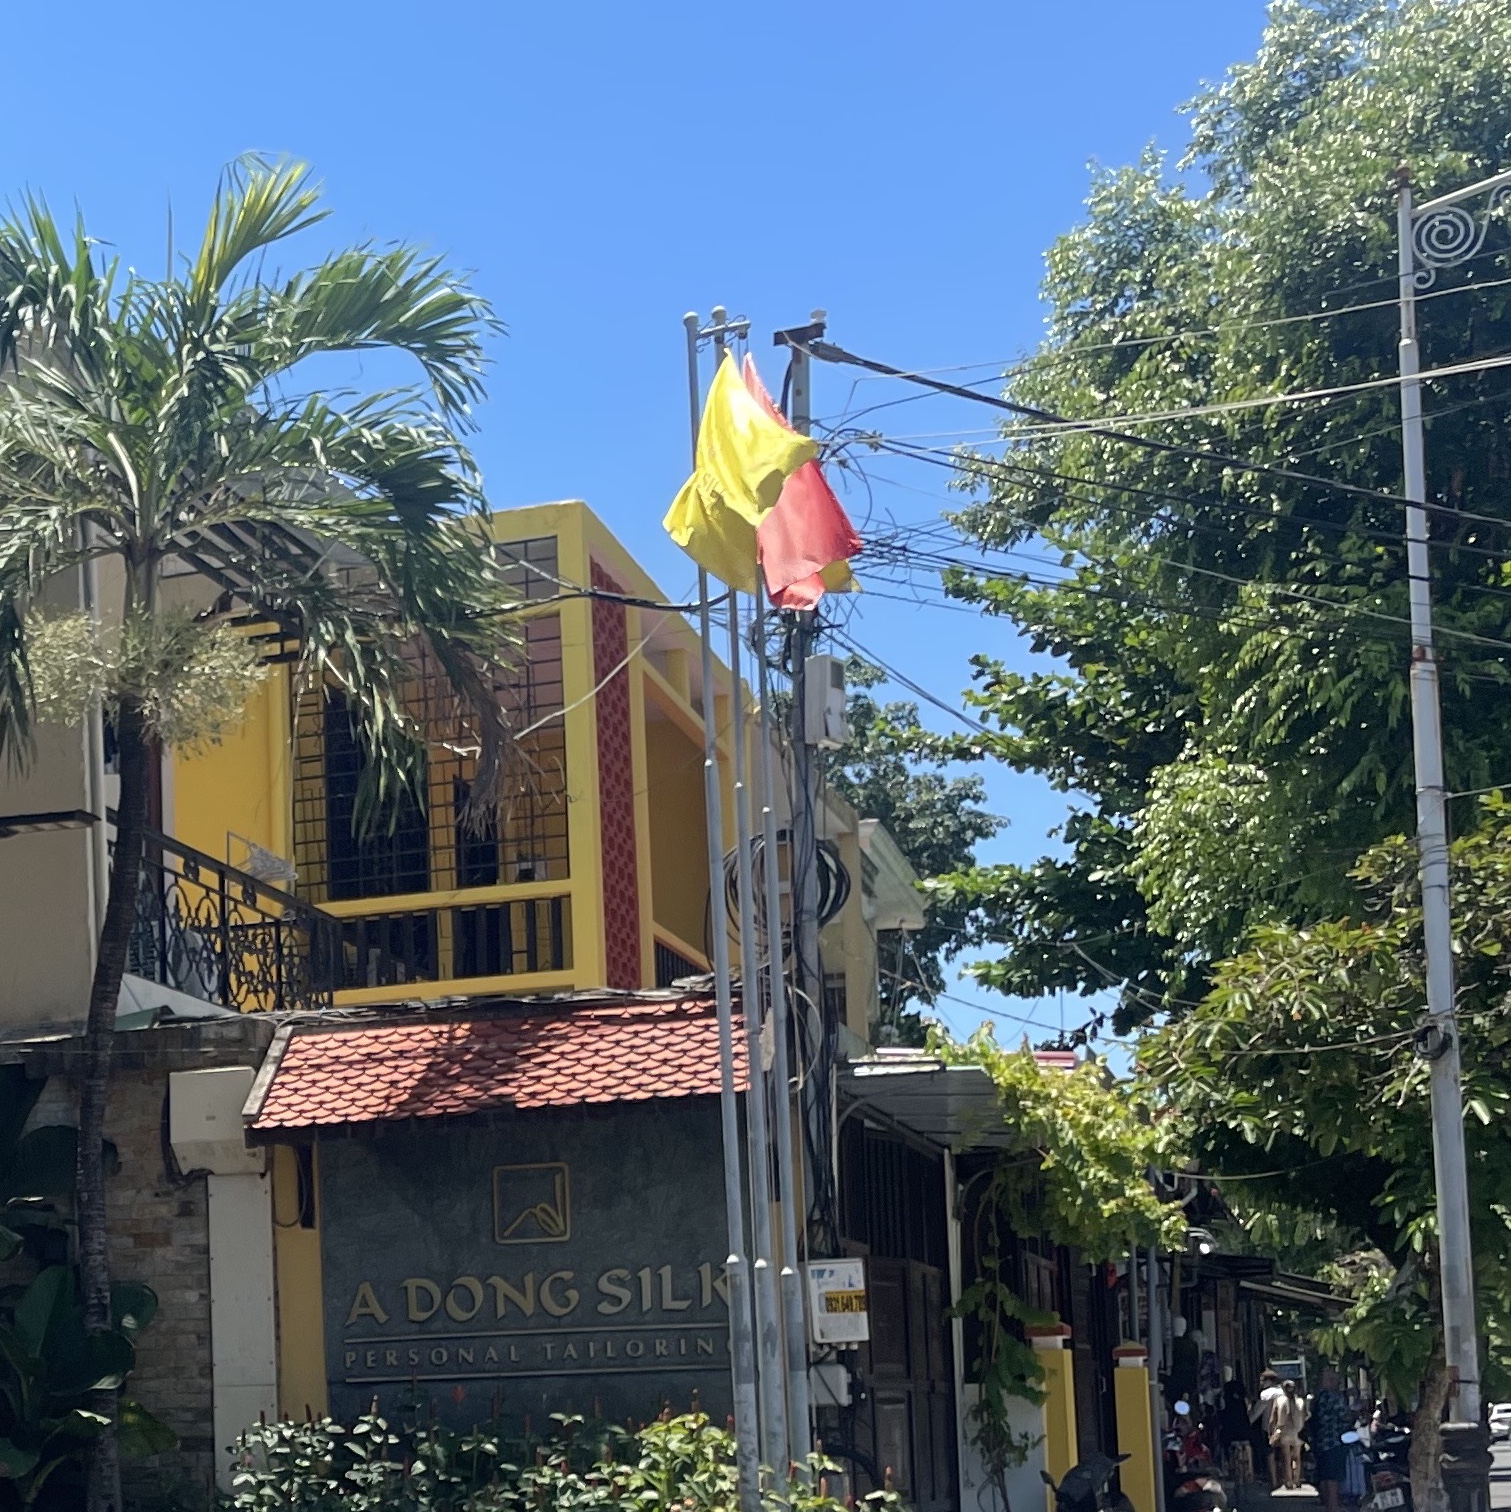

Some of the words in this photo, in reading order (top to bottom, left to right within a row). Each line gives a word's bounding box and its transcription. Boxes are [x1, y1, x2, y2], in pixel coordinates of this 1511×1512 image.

[345, 1280, 390, 1327] A
[399, 1270, 580, 1323] DONG
[596, 1262, 729, 1315] SILK
[344, 1347, 521, 1368] PERSONAL
[546, 1336, 731, 1361] TAILORIN
